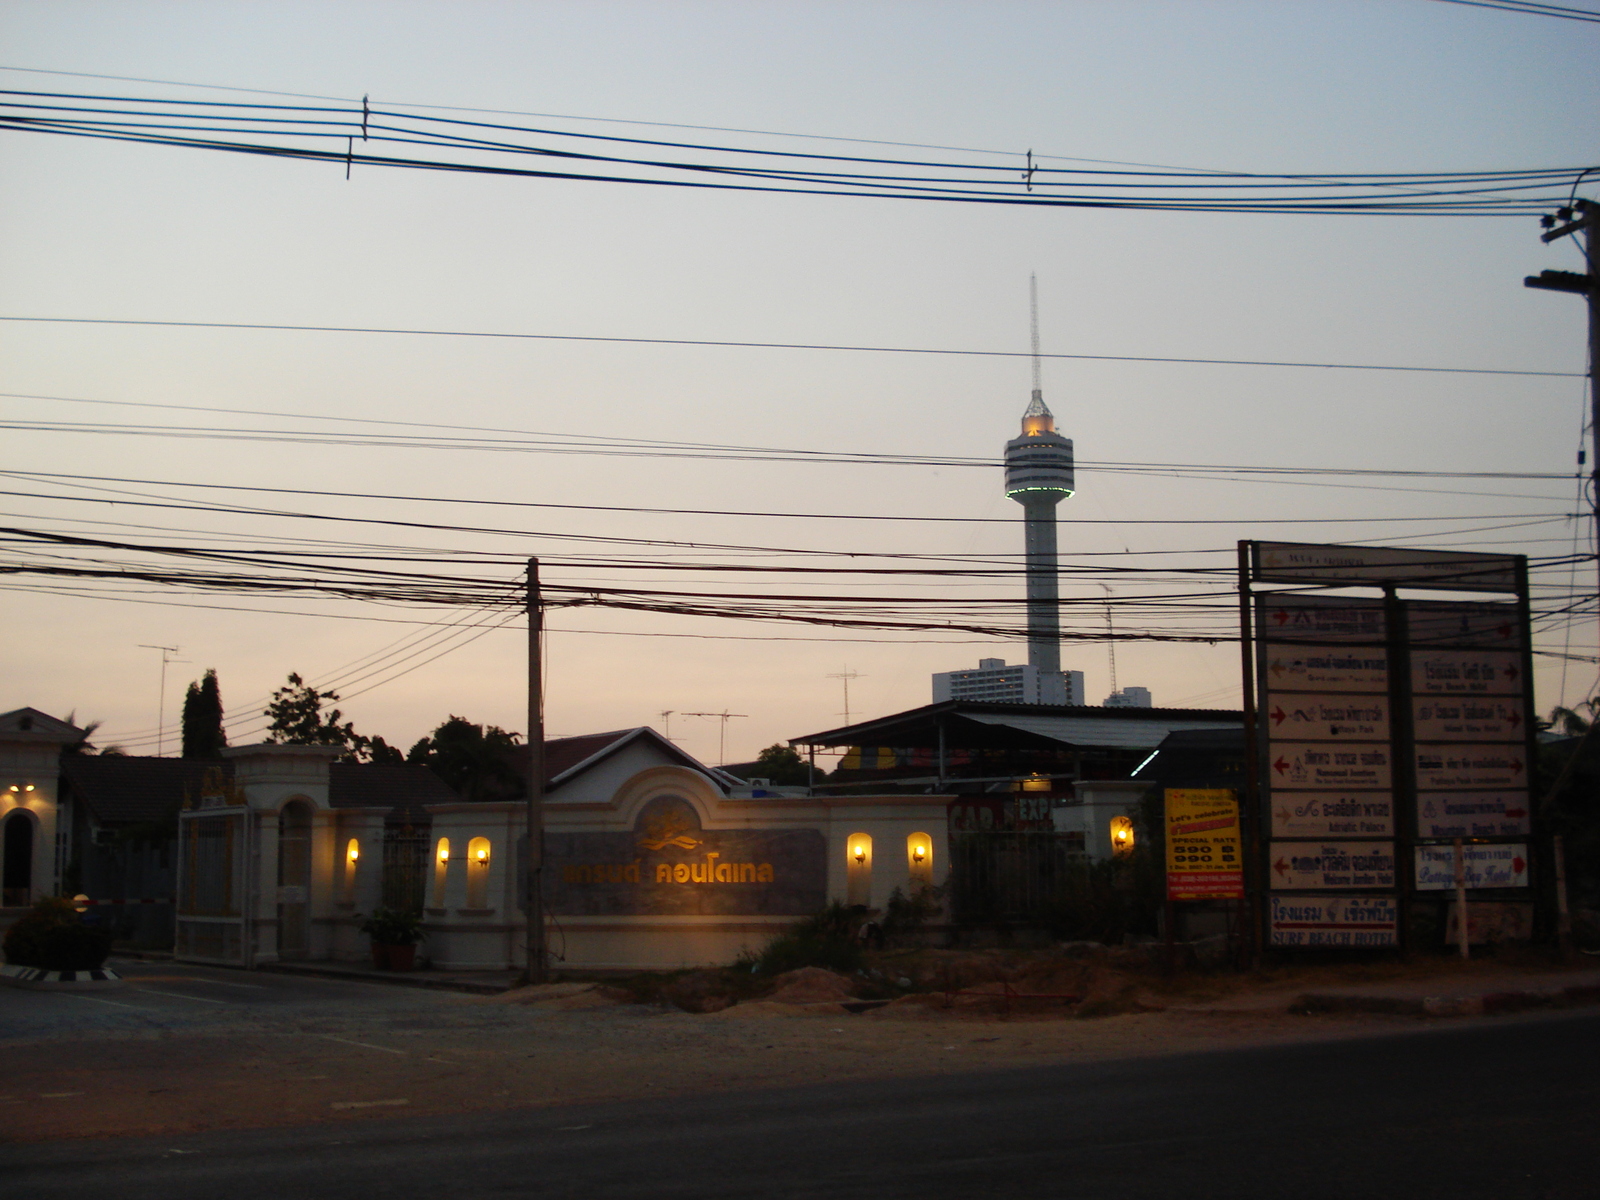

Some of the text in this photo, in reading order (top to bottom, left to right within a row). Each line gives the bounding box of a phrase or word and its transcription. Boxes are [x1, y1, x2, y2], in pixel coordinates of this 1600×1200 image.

[1194, 808, 1234, 820] celebrate
[1174, 846, 1212, 854] 590
[1174, 855, 1212, 863] 990
[656, 852, 774, 883] คอนโดเทล
[1272, 898, 1322, 921] โรงแรม
[1272, 930, 1394, 946] SURF BEACH HOTEL
